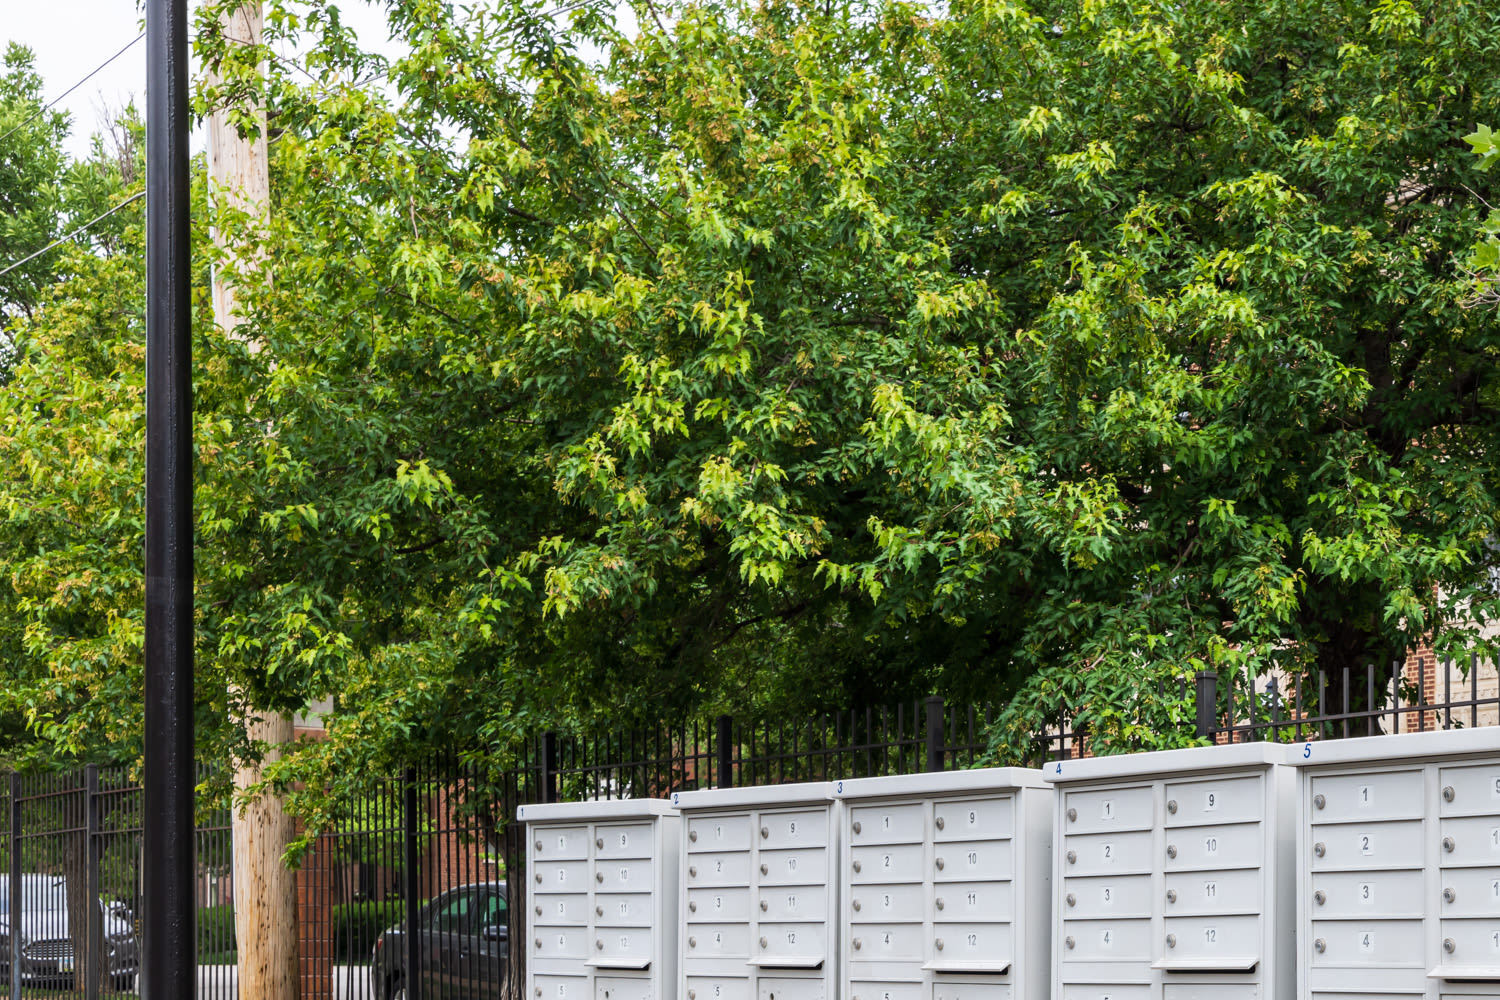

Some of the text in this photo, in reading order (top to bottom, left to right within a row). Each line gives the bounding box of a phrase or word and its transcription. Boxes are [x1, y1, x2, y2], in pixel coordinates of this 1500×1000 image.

[1303, 743, 1312, 759] 5
[1055, 762, 1062, 775] 4
[837, 781, 843, 794] 3
[674, 793, 679, 805] 2
[1208, 793, 1215, 807] 9
[1362, 787, 1368, 802] 1
[1105, 802, 1110, 816] 1
[884, 816, 889, 828] 1
[969, 811, 975, 824] 9
[790, 822, 796, 834] 9
[1206, 838, 1217, 852] 10
[1362, 836, 1369, 851] 2
[1104, 845, 1111, 858] 2
[788, 858, 797, 870] 10
[884, 855, 890, 868] 2
[967, 852, 977, 865] 10
[716, 861, 722, 873] 2
[1104, 888, 1110, 902] 3
[1205, 883, 1216, 897] 11
[1362, 884, 1370, 900] 3
[716, 897, 721, 909] 3
[788, 895, 796, 907] 11
[884, 894, 890, 907] 3
[967, 892, 976, 905] 11
[716, 933, 721, 944] 4
[787, 932, 796, 944] 12
[884, 932, 890, 945] 4
[967, 934, 977, 946] 12
[1103, 930, 1110, 944] 4
[1205, 929, 1216, 943] 12
[1362, 933, 1370, 948] 4
[715, 984, 720, 997] 5
